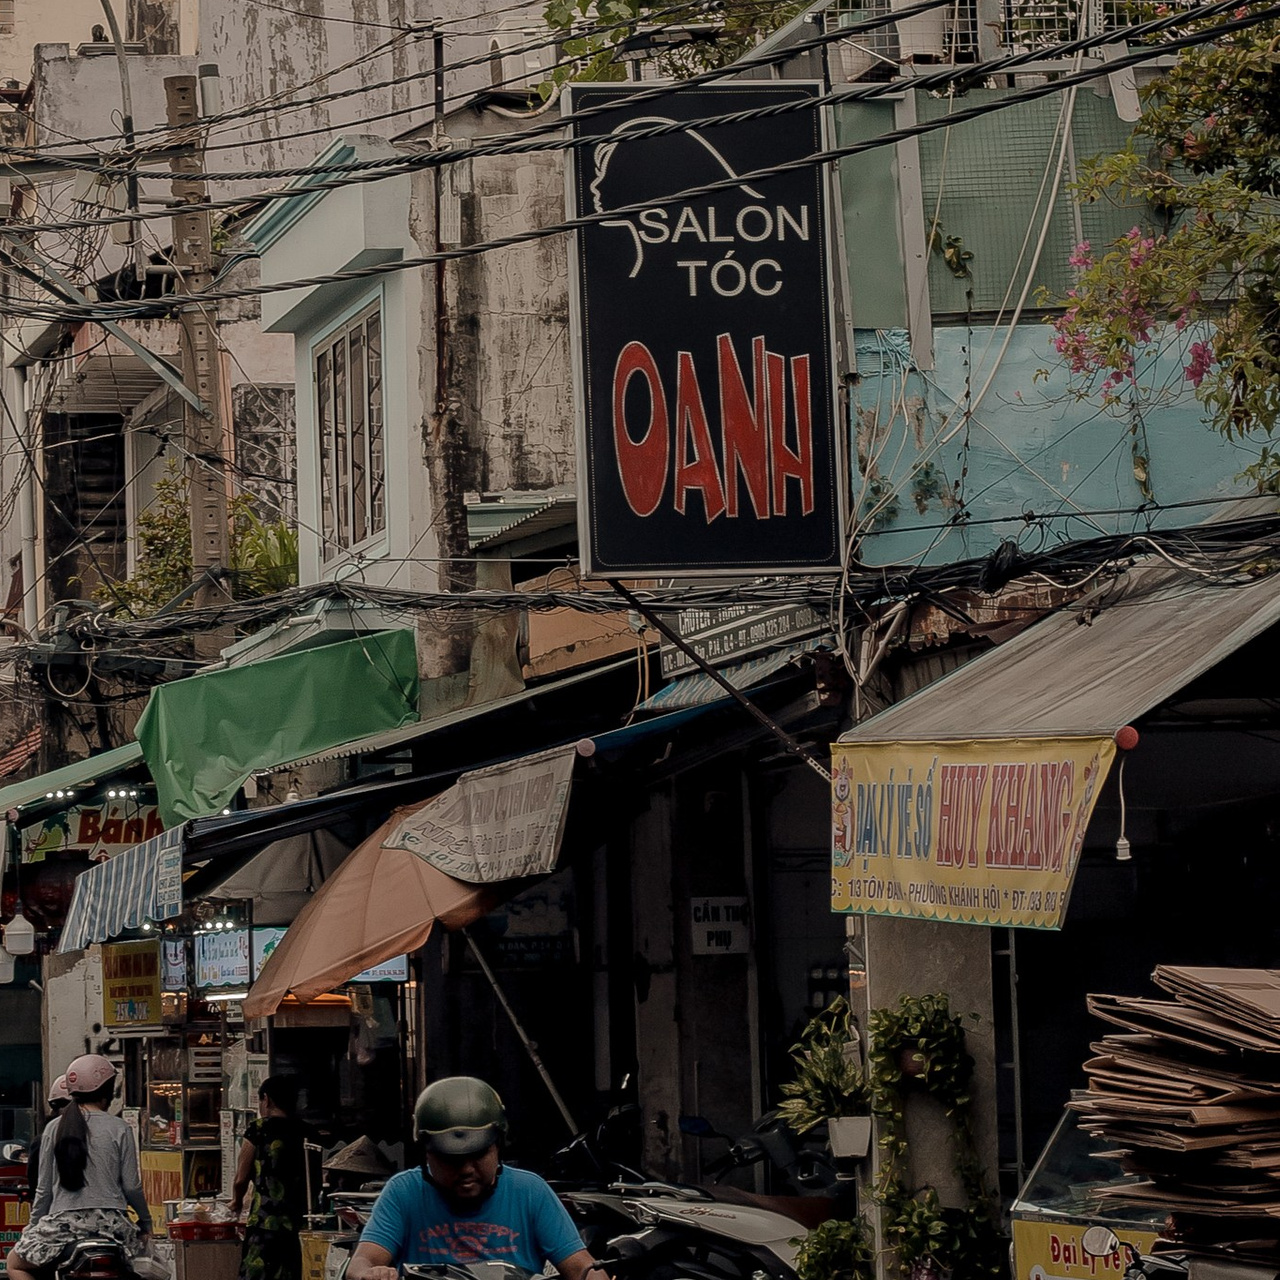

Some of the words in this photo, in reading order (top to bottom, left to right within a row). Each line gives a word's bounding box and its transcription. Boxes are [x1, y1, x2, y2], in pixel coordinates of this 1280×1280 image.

[677, 251, 784, 298] TÓC
[612, 332, 815, 525] OANH
[78, 807, 165, 844] Bánh
[936, 763, 988, 869] HUY
[985, 759, 1074, 872] KHANG
[948, 882, 980, 908] KHÁNH
[982, 884, 1001, 914] HỘI
[1051, 1234, 1077, 1272] Đại
